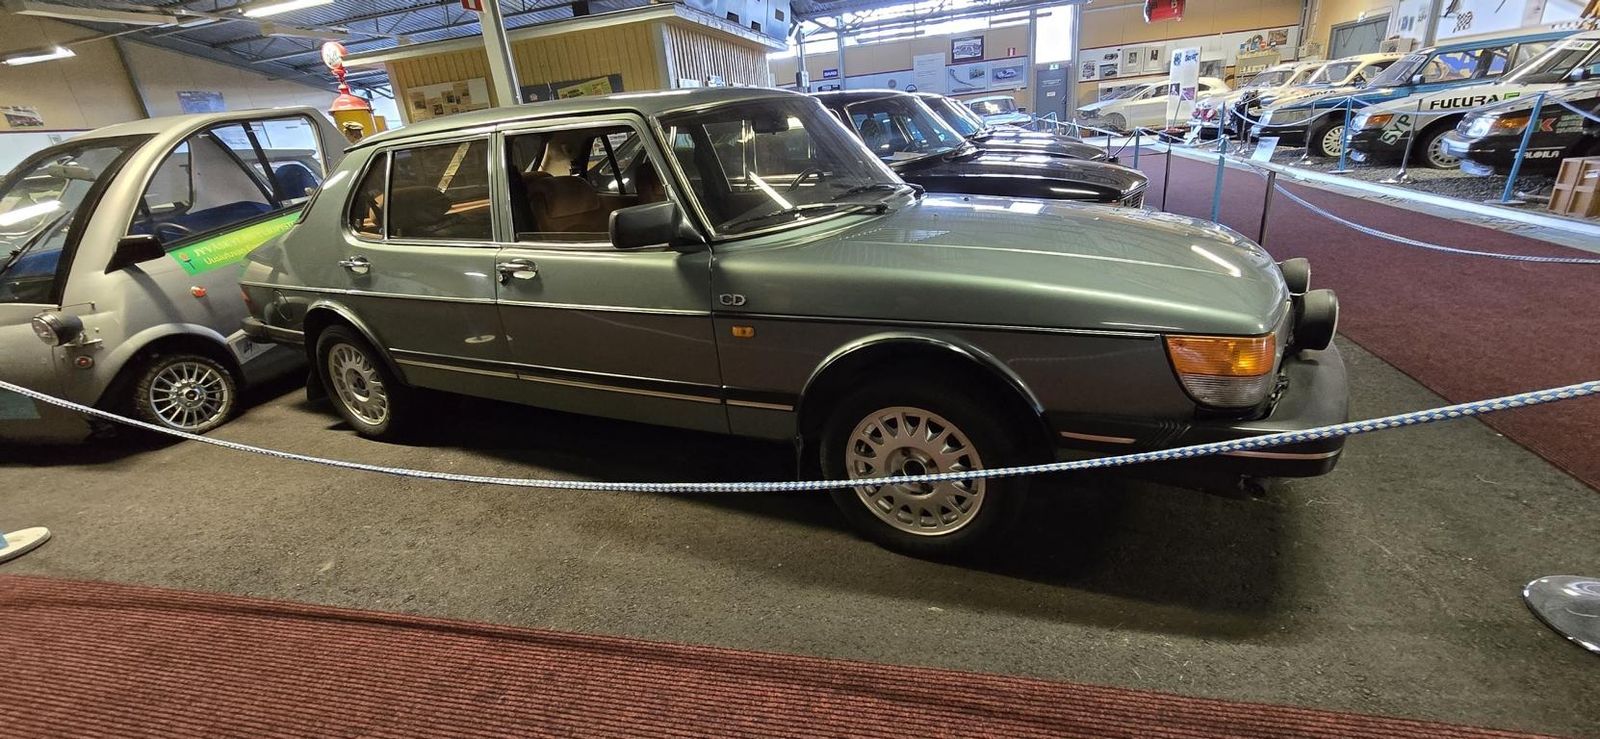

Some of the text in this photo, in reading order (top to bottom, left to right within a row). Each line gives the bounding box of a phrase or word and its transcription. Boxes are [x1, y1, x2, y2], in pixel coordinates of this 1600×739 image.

[1429, 94, 1499, 110] FUTURA
[1382, 114, 1411, 144] SYP
[720, 294, 747, 306] CD
